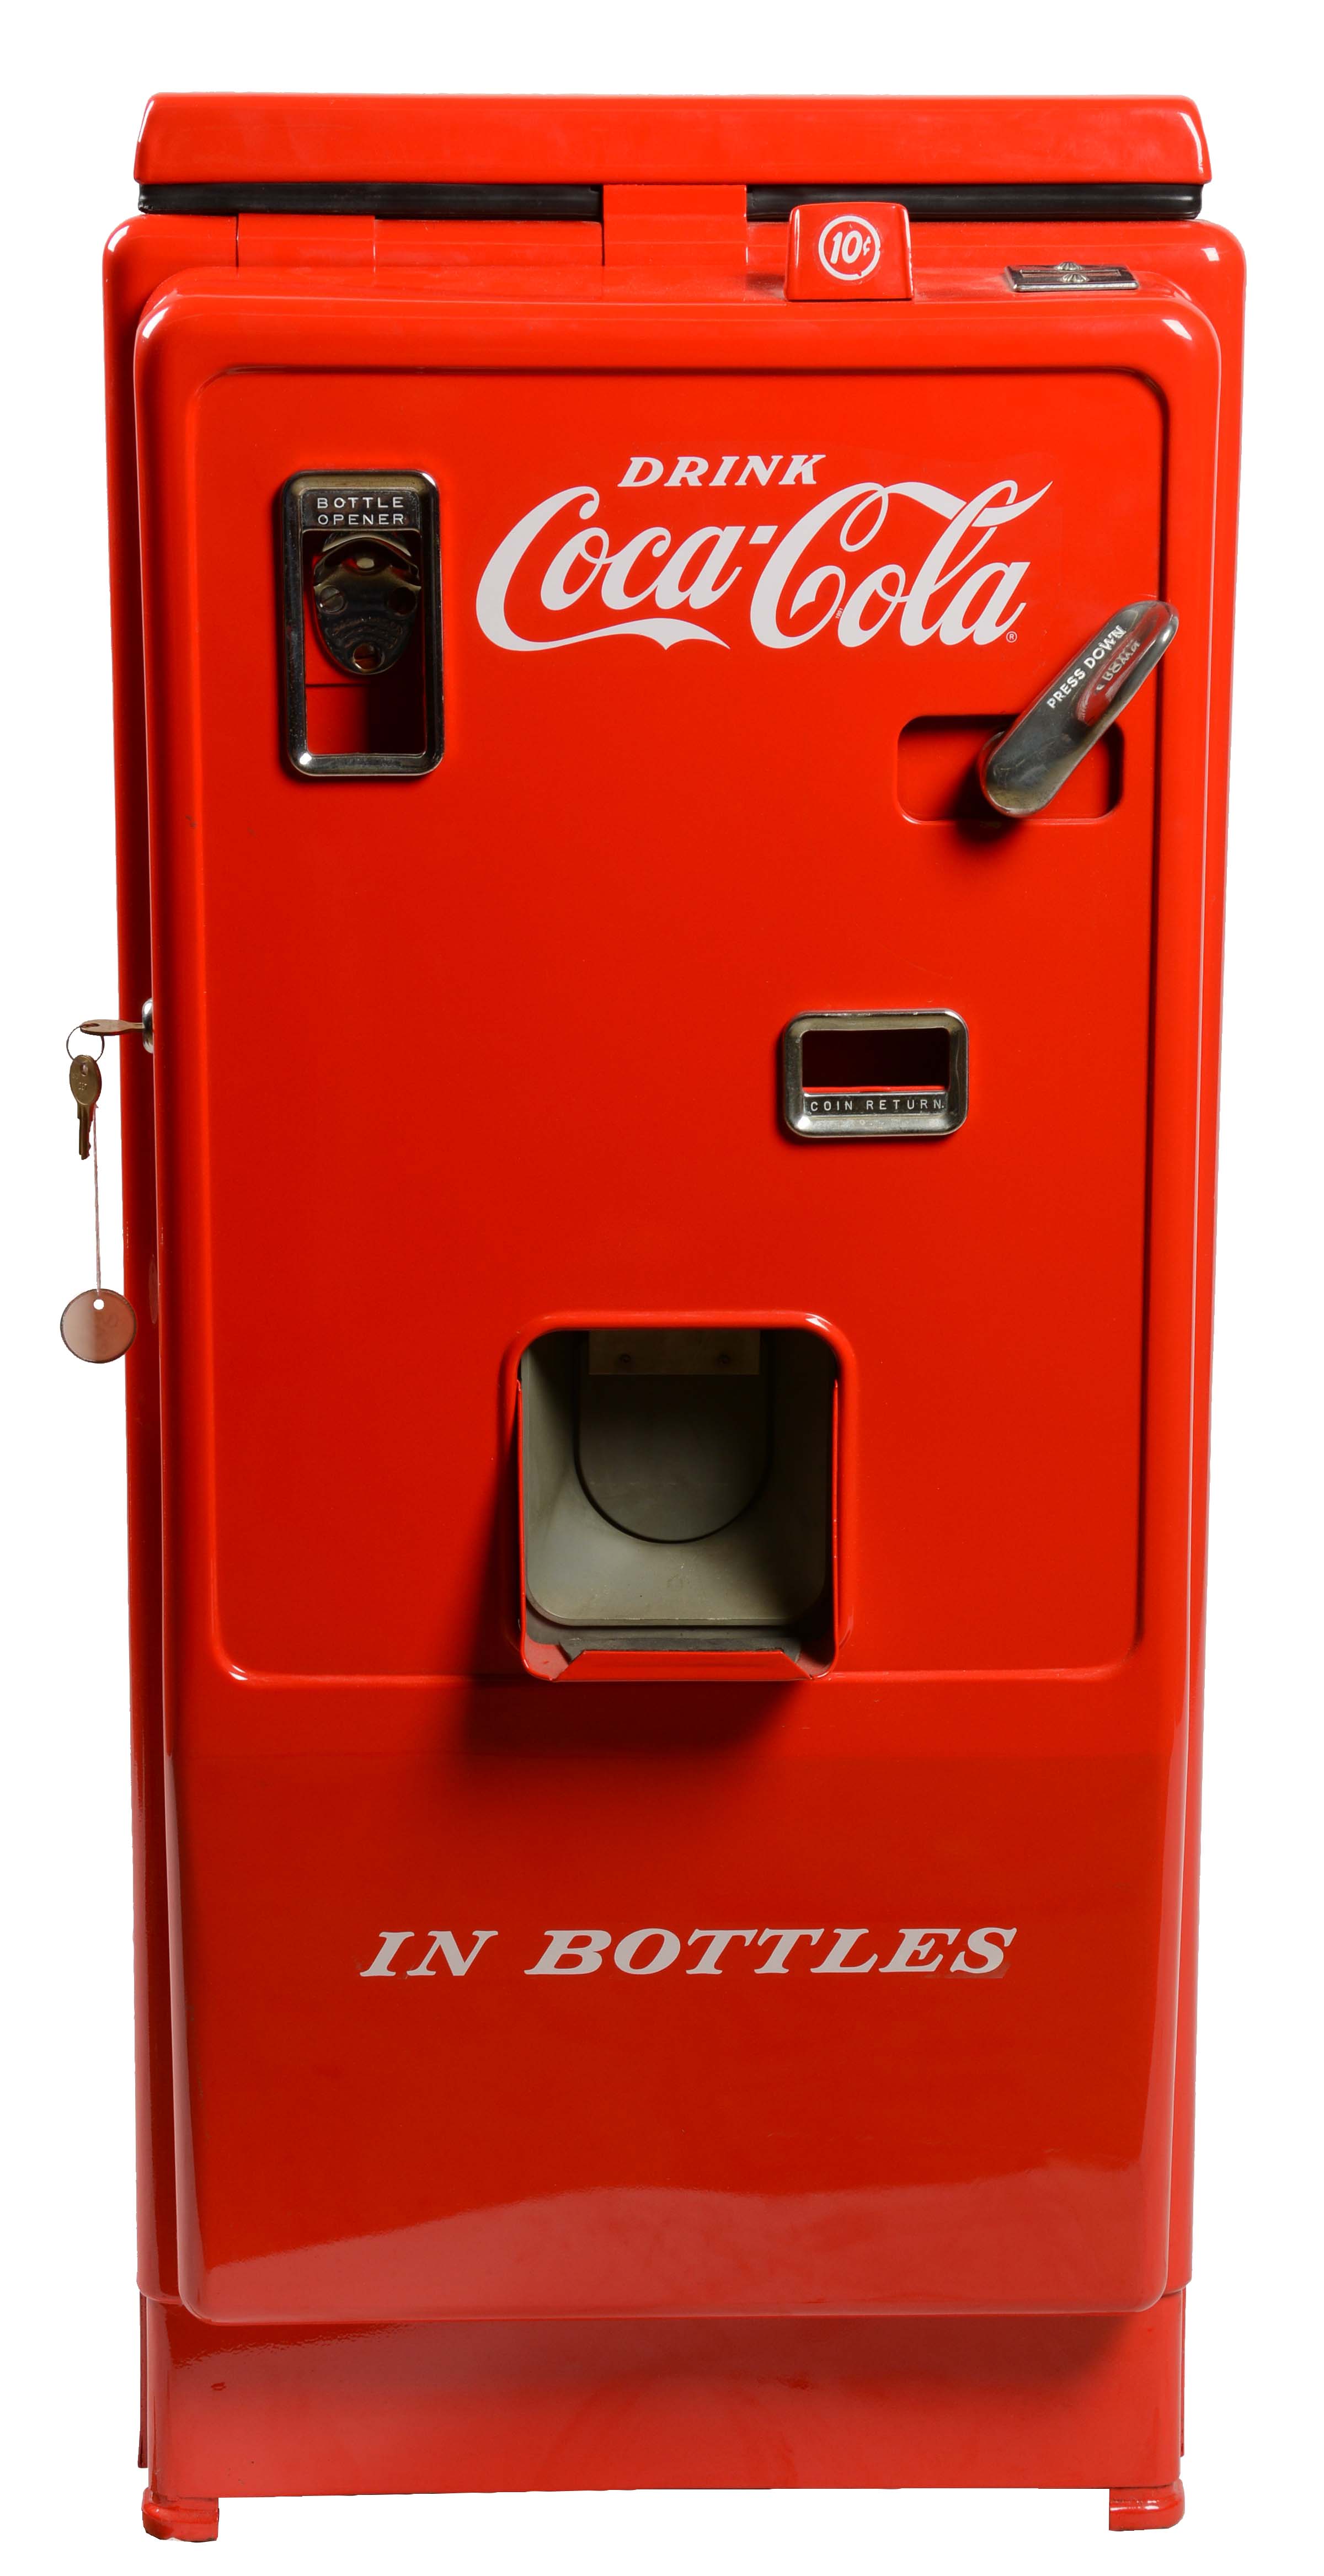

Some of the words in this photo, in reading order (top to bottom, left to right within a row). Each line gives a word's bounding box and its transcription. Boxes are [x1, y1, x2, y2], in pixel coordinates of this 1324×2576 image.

[617, 454, 826, 487] DRINK
[317, 496, 404, 509] BOTTLE
[317, 514, 405, 525] OPENER
[476, 480, 1053, 651] Coca-Cola
[1047, 668, 1086, 709] PRESS
[1083, 624, 1127, 670] DOWN
[810, 1100, 853, 1111] COIN
[866, 1099, 942, 1110] RETURN
[360, 1930, 498, 1977] IN
[524, 1927, 1017, 1975] BOTTLES
